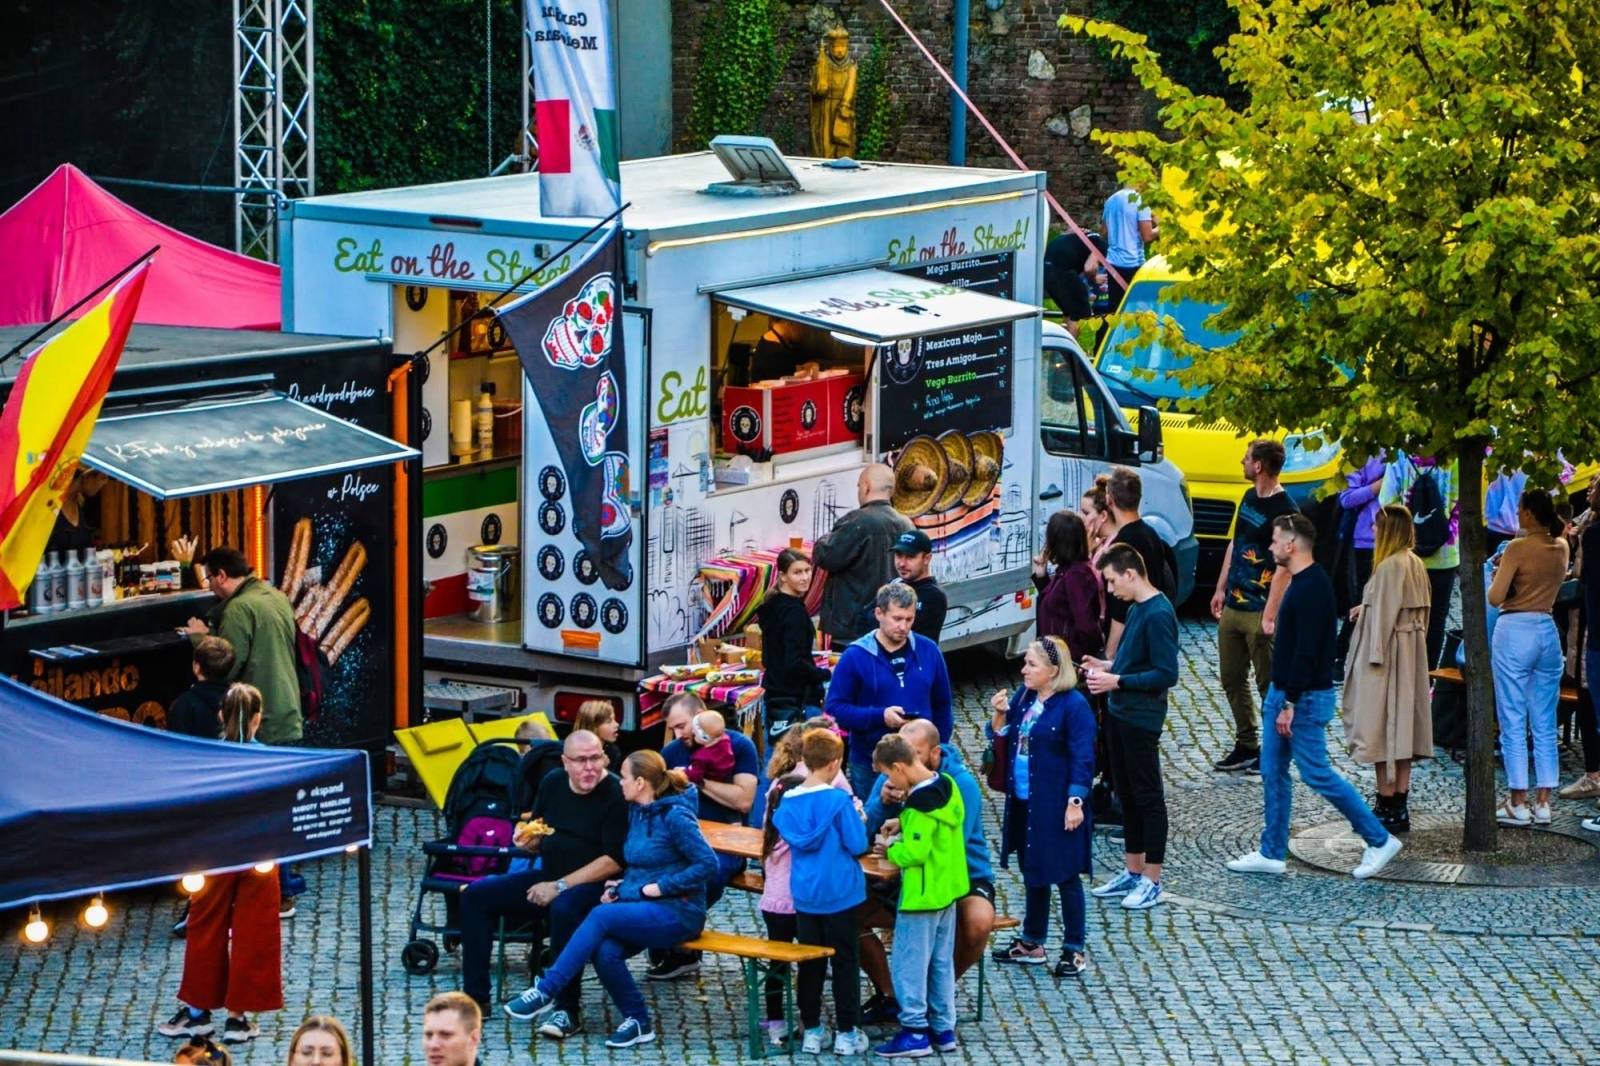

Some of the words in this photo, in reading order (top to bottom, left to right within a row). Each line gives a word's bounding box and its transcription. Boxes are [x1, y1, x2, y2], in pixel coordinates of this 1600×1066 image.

[888, 235, 916, 265] Eat
[919, 246, 940, 261] on
[940, 227, 968, 257] the
[334, 237, 384, 273] Eat
[391, 254, 424, 277] on
[426, 242, 475, 280] the
[926, 265, 950, 276] Mega
[926, 337, 961, 351] Mexican
[962, 332, 983, 345] Mojo
[926, 359, 945, 370] Tres
[945, 353, 978, 366] Amigos
[926, 379, 947, 390] Vege
[947, 371, 978, 384] Burrito
[657, 366, 708, 424] Eat
[341, 473, 380, 502] Polsce
[310, 782, 344, 797] ekspand
